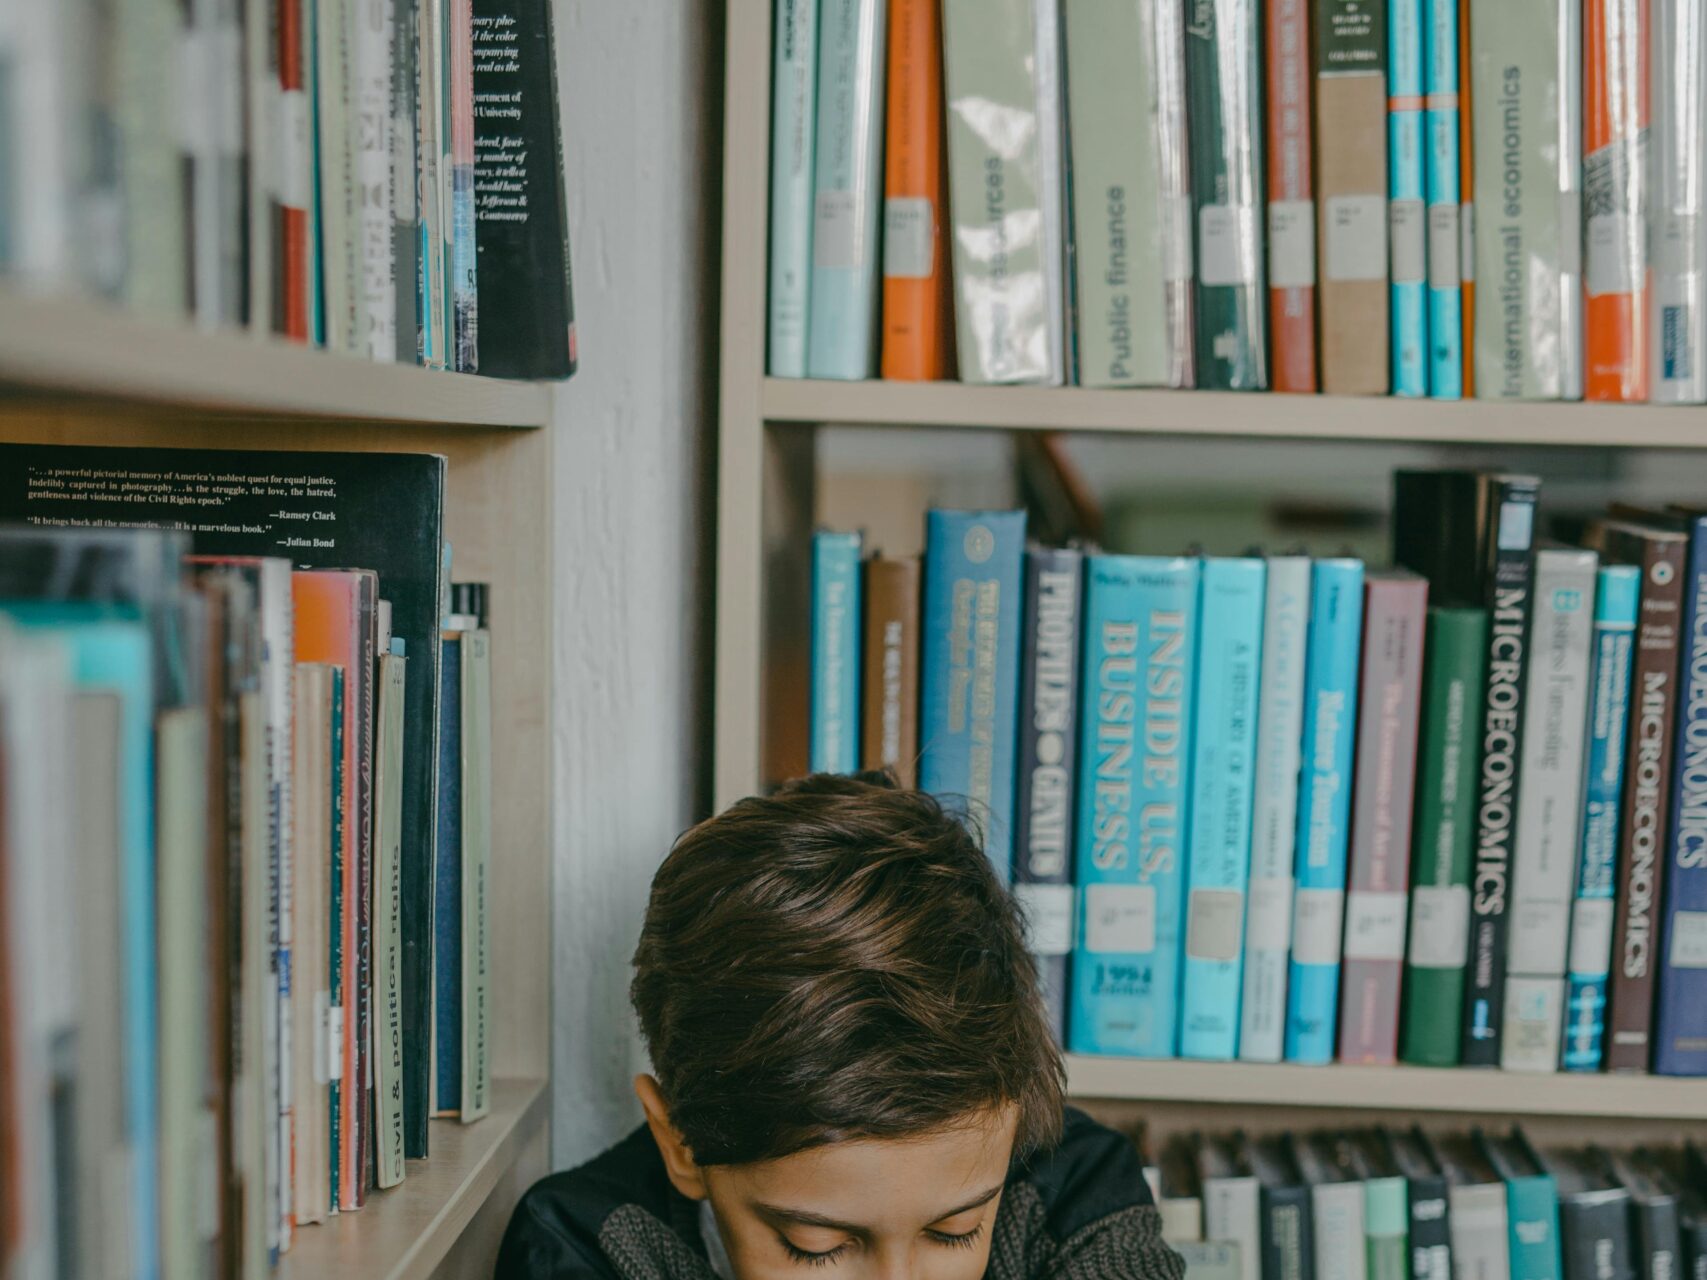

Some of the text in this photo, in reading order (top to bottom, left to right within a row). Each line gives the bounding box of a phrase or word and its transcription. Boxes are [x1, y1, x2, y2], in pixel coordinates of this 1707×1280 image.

[479, 31, 494, 41] the
[495, 30, 518, 41] color
[476, 61, 520, 72] real as the
[511, 91, 522, 102] of
[479, 106, 522, 120] University
[515, 151, 528, 165] of
[1502, 66, 1522, 397] International economics
[1107, 185, 1130, 379] Public finance
[55, 468, 92, 478] powerful
[93, 469, 128, 479] pictorial
[129, 472, 162, 480] memory
[164, 472, 174, 480] of
[217, 473, 246, 482] noblest
[247, 475, 269, 484] quest
[270, 475, 283, 484] for
[284, 476, 306, 485] equal
[307, 476, 337, 486] justice.
[28, 478, 65, 489] Indelibly
[69, 480, 106, 490] captured
[109, 481, 118, 490] in
[196, 484, 209, 493] the
[212, 486, 249, 496] struggle,
[252, 486, 265, 495] the
[268, 487, 288, 497] love,
[291, 487, 304, 496] the
[307, 488, 337, 498] hatred,
[28, 491, 70, 500] gentleness
[72, 492, 88, 500] and
[90, 492, 122, 501] violence
[124, 493, 134, 502] of
[134, 494, 146, 502] the
[148, 494, 168, 503] Civil
[170, 495, 196, 505] Rights
[43, 517, 69, 527] brings
[70, 517, 90, 526] back
[92, 519, 103, 527] all
[104, 519, 117, 528] the
[184, 522, 191, 531] is
[198, 524, 241, 533] marvelous
[312, 511, 337, 521] Clark
[313, 538, 335, 548] Bond
[1028, 570, 1076, 877] PROFILES GENIUS
[1092, 621, 1139, 871] BUSINESS
[1138, 610, 1185, 883] INSIDE U.S.
[1474, 588, 1527, 914] MICROECONOMICS
[1307, 690, 1345, 868] Nature Tourism
[1622, 671, 1668, 978] MICROECONOMICS
[474, 863, 486, 1110] Electoral process
[387, 844, 402, 1179] Civil & political rights
